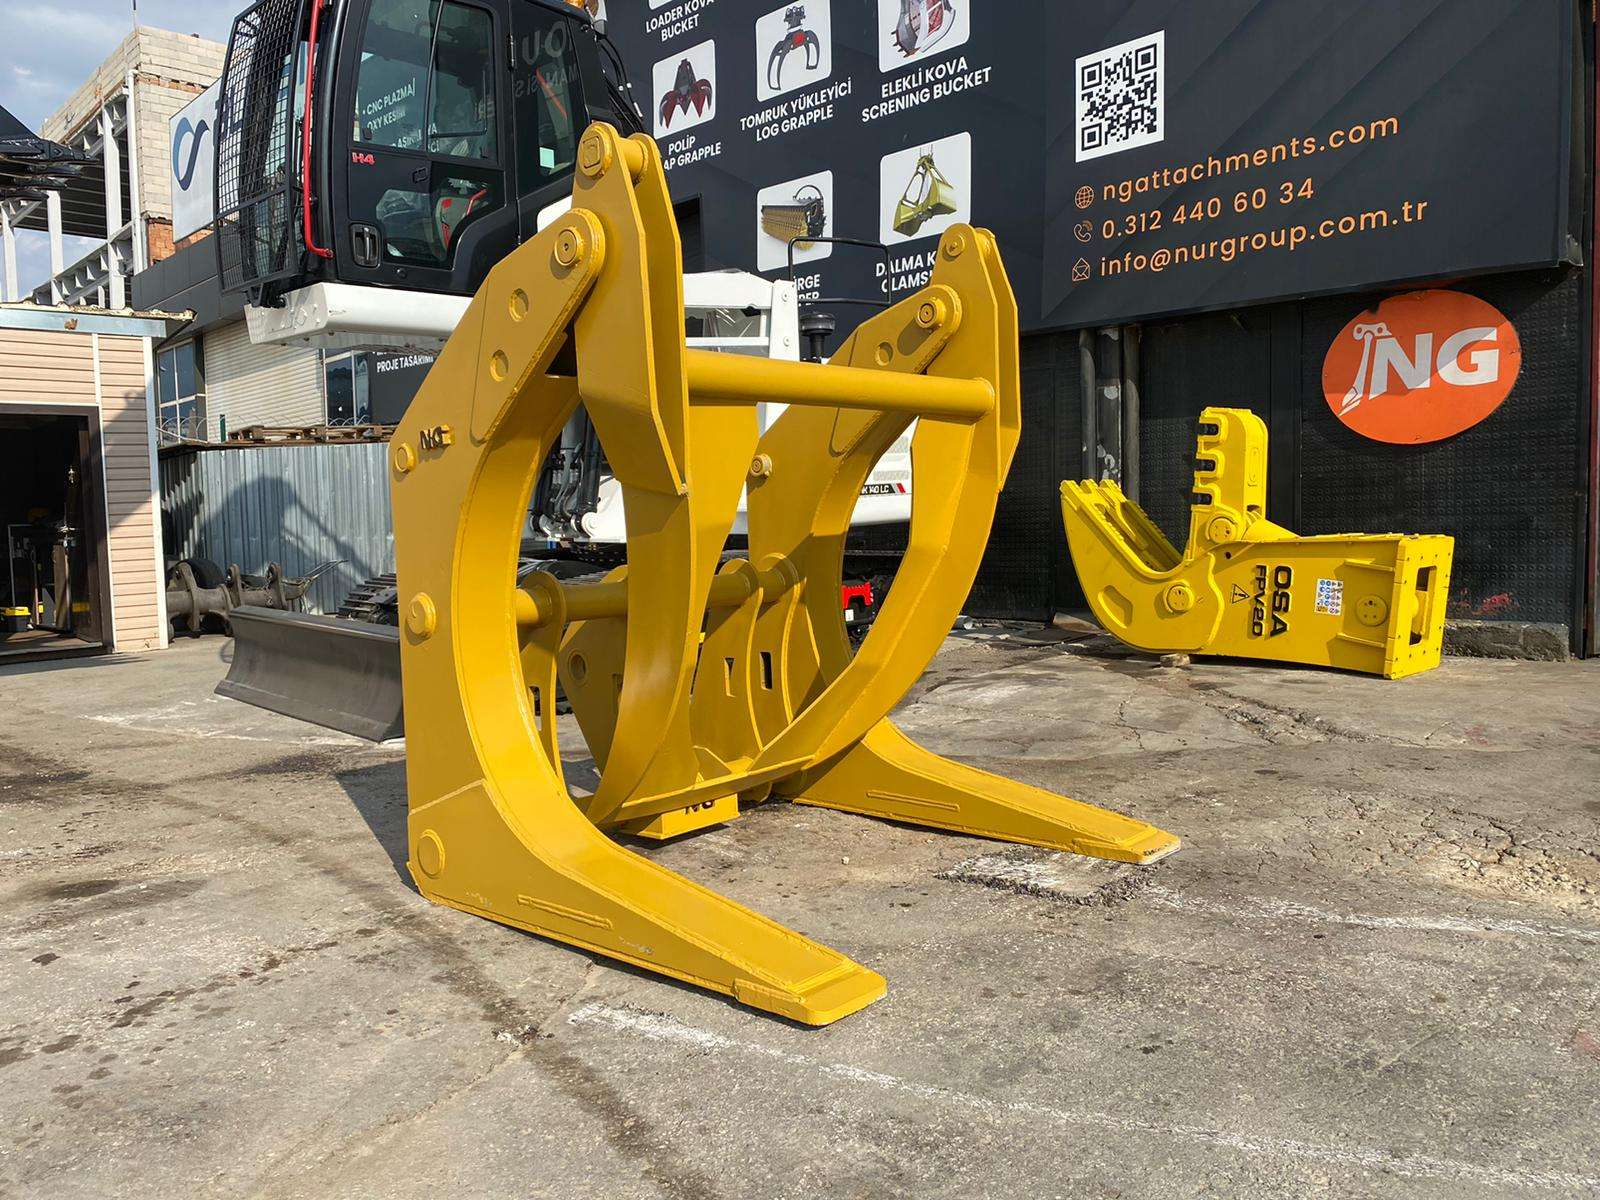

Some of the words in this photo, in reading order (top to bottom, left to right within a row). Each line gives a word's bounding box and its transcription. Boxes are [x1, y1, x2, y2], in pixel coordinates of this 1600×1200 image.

[646, 6, 683, 33] LOADER
[661, 14, 699, 42] BUCKET
[862, 88, 930, 122] SCRENING
[933, 67, 992, 100] BUCKET
[881, 68, 922, 98] ELEKLİ
[925, 56, 968, 83] KOVA
[367, 99, 383, 115] CNC
[740, 103, 788, 131] TOMRUK
[791, 77, 852, 113] YÜKLEYİCİ
[756, 123, 779, 142] LOG
[781, 104, 833, 133] GRAPPLE
[668, 135, 696, 155] POLİP
[677, 142, 721, 166] GRAPPLE
[1103, 116, 1398, 203] ngattachments.com
[1102, 210, 1162, 239] 0.312
[1172, 197, 1221, 224] 440
[1234, 188, 1266, 213] 60
[1279, 177, 1313, 204] 34
[1100, 200, 1428, 277] info@nurgroup.com.tr
[881, 270, 933, 293] CLAMS
[377, 358, 399, 373] PROJE
[1369, 326, 1500, 401] NG
[1270, 565, 1293, 637] OSA
